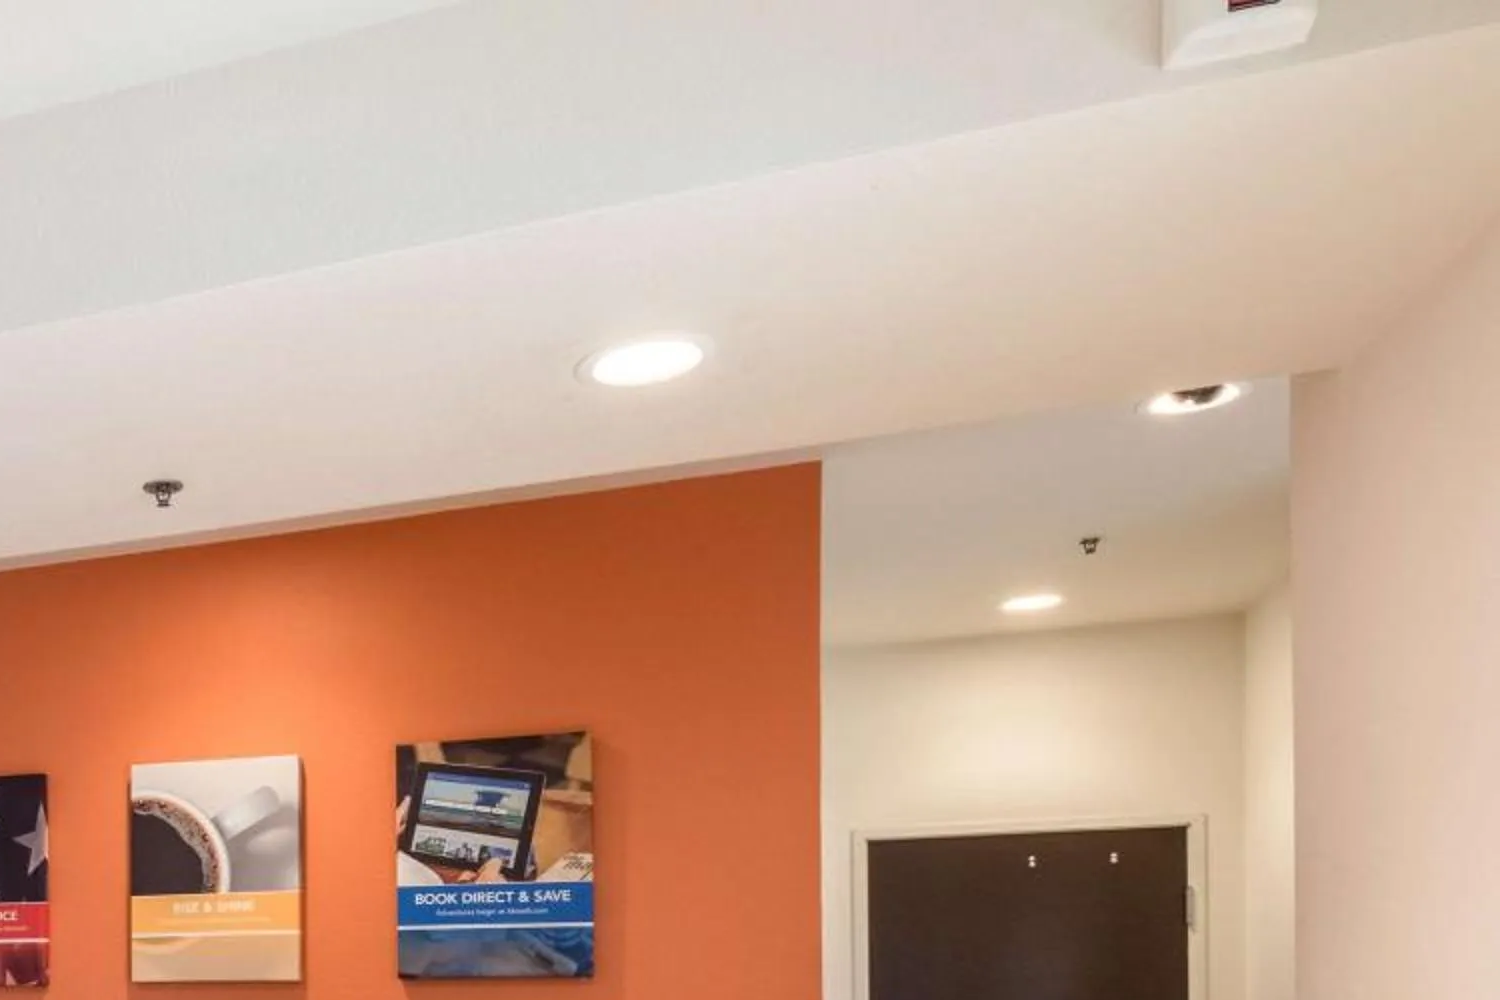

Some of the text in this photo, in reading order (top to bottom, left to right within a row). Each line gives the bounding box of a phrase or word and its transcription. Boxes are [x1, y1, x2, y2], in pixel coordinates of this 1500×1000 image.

[414, 889, 572, 906] BOOK DIRECT & SAVE
